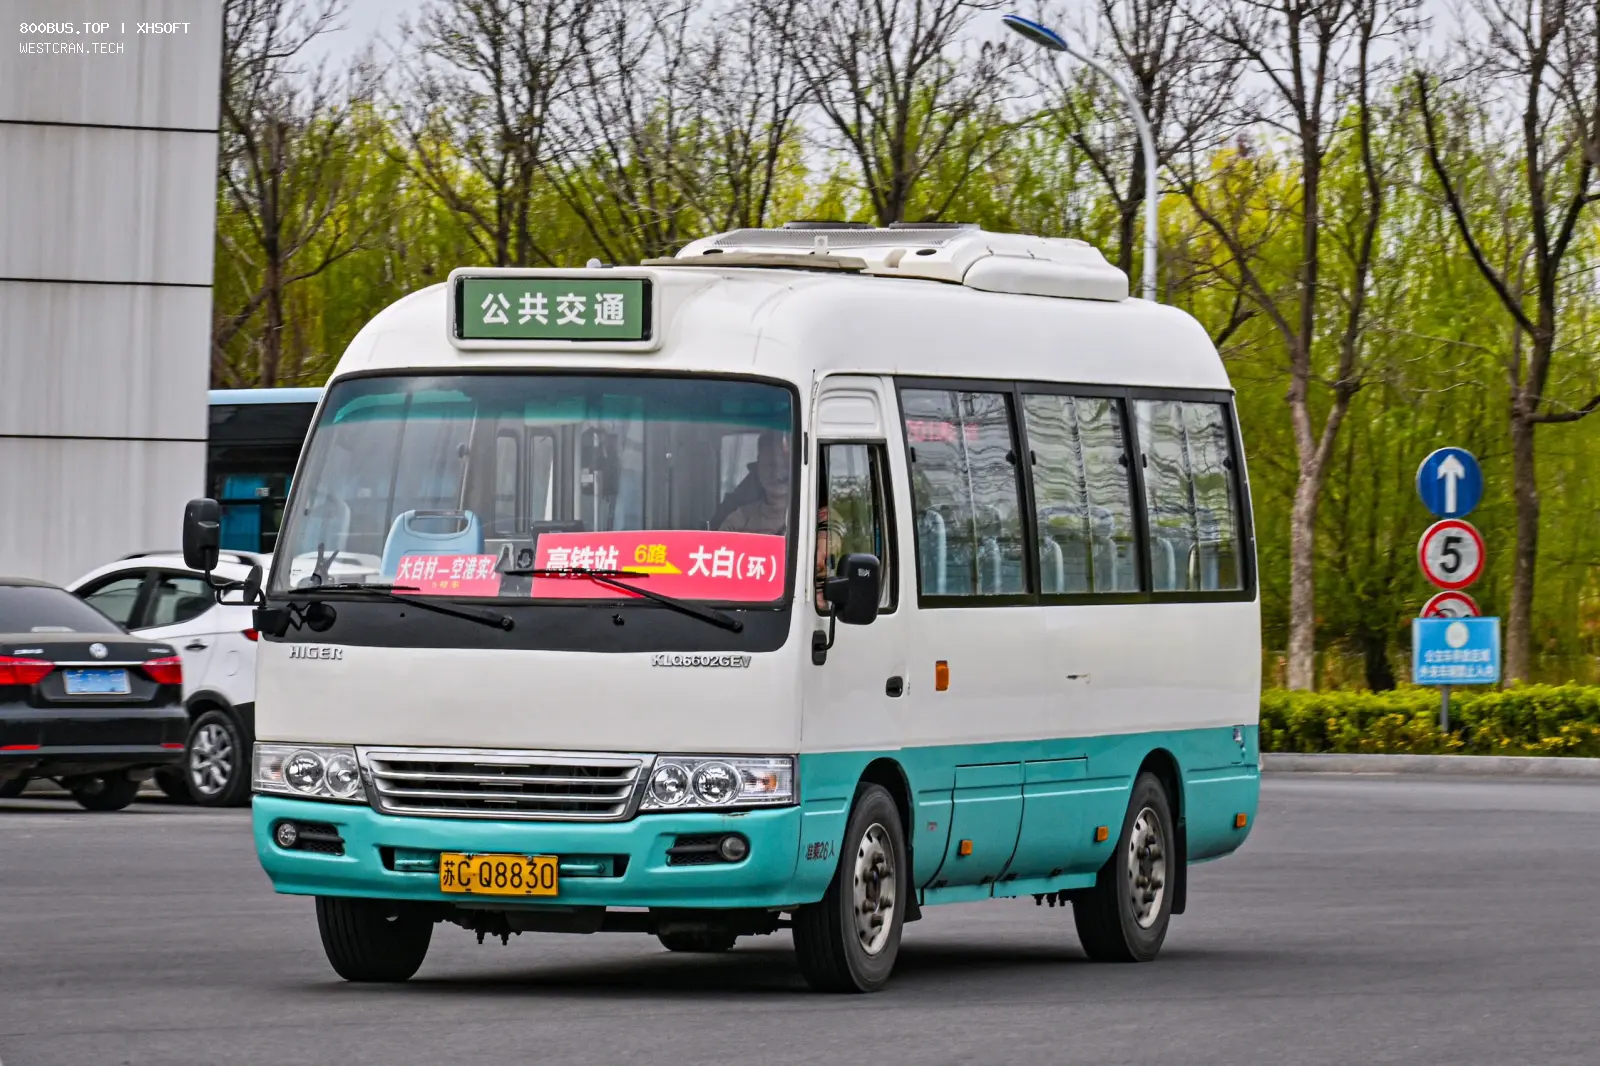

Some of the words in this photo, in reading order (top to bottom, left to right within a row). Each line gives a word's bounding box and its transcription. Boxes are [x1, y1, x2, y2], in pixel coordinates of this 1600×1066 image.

[480, 292, 625, 326] 公共交通
[546, 545, 619, 578] 高铁站
[634, 544, 668, 565] 6路
[1439, 536, 1463, 574] 5
[289, 646, 343, 661] HIGER
[652, 654, 752, 669] KLQ6602GEV
